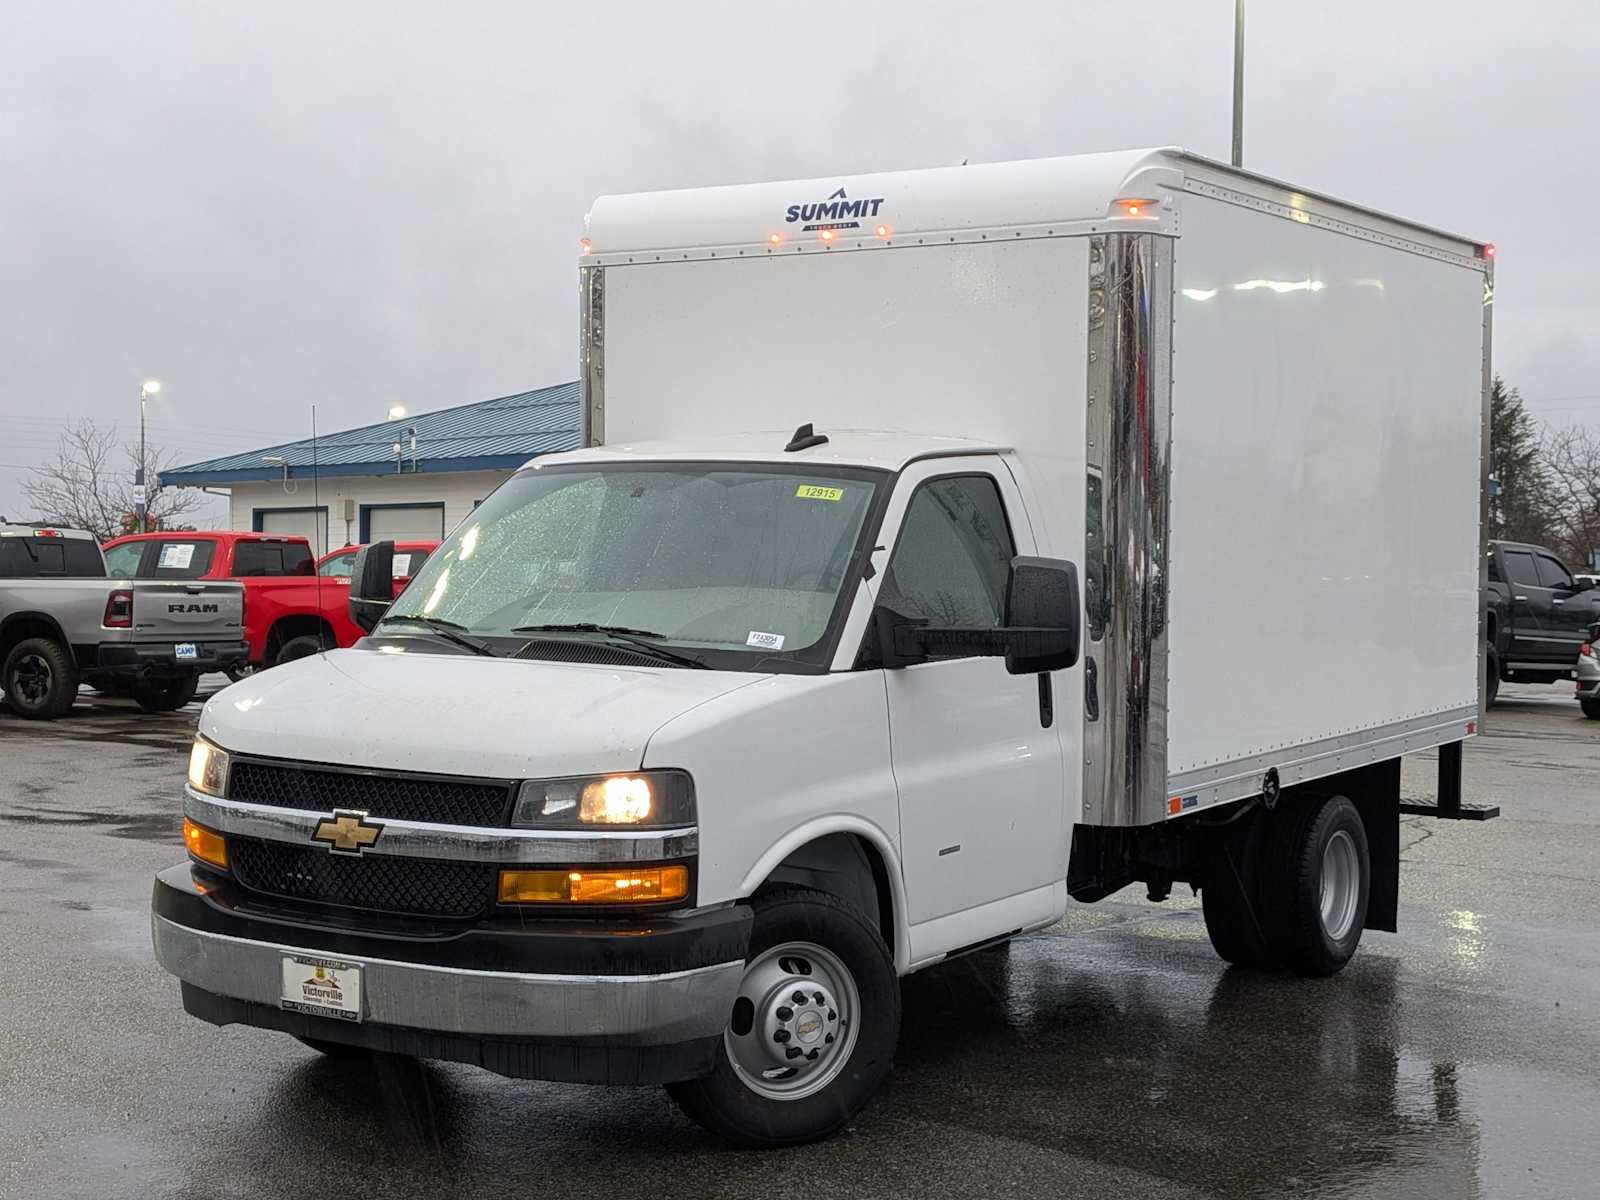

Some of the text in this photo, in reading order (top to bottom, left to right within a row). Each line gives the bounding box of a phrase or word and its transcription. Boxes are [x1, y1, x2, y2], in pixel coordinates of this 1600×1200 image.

[785, 198, 885, 222] SUMMIT
[805, 487, 836, 498] 12915
[168, 604, 218, 613] RAM
[176, 647, 194, 655] CAMP
[303, 985, 343, 1000] Victorville
